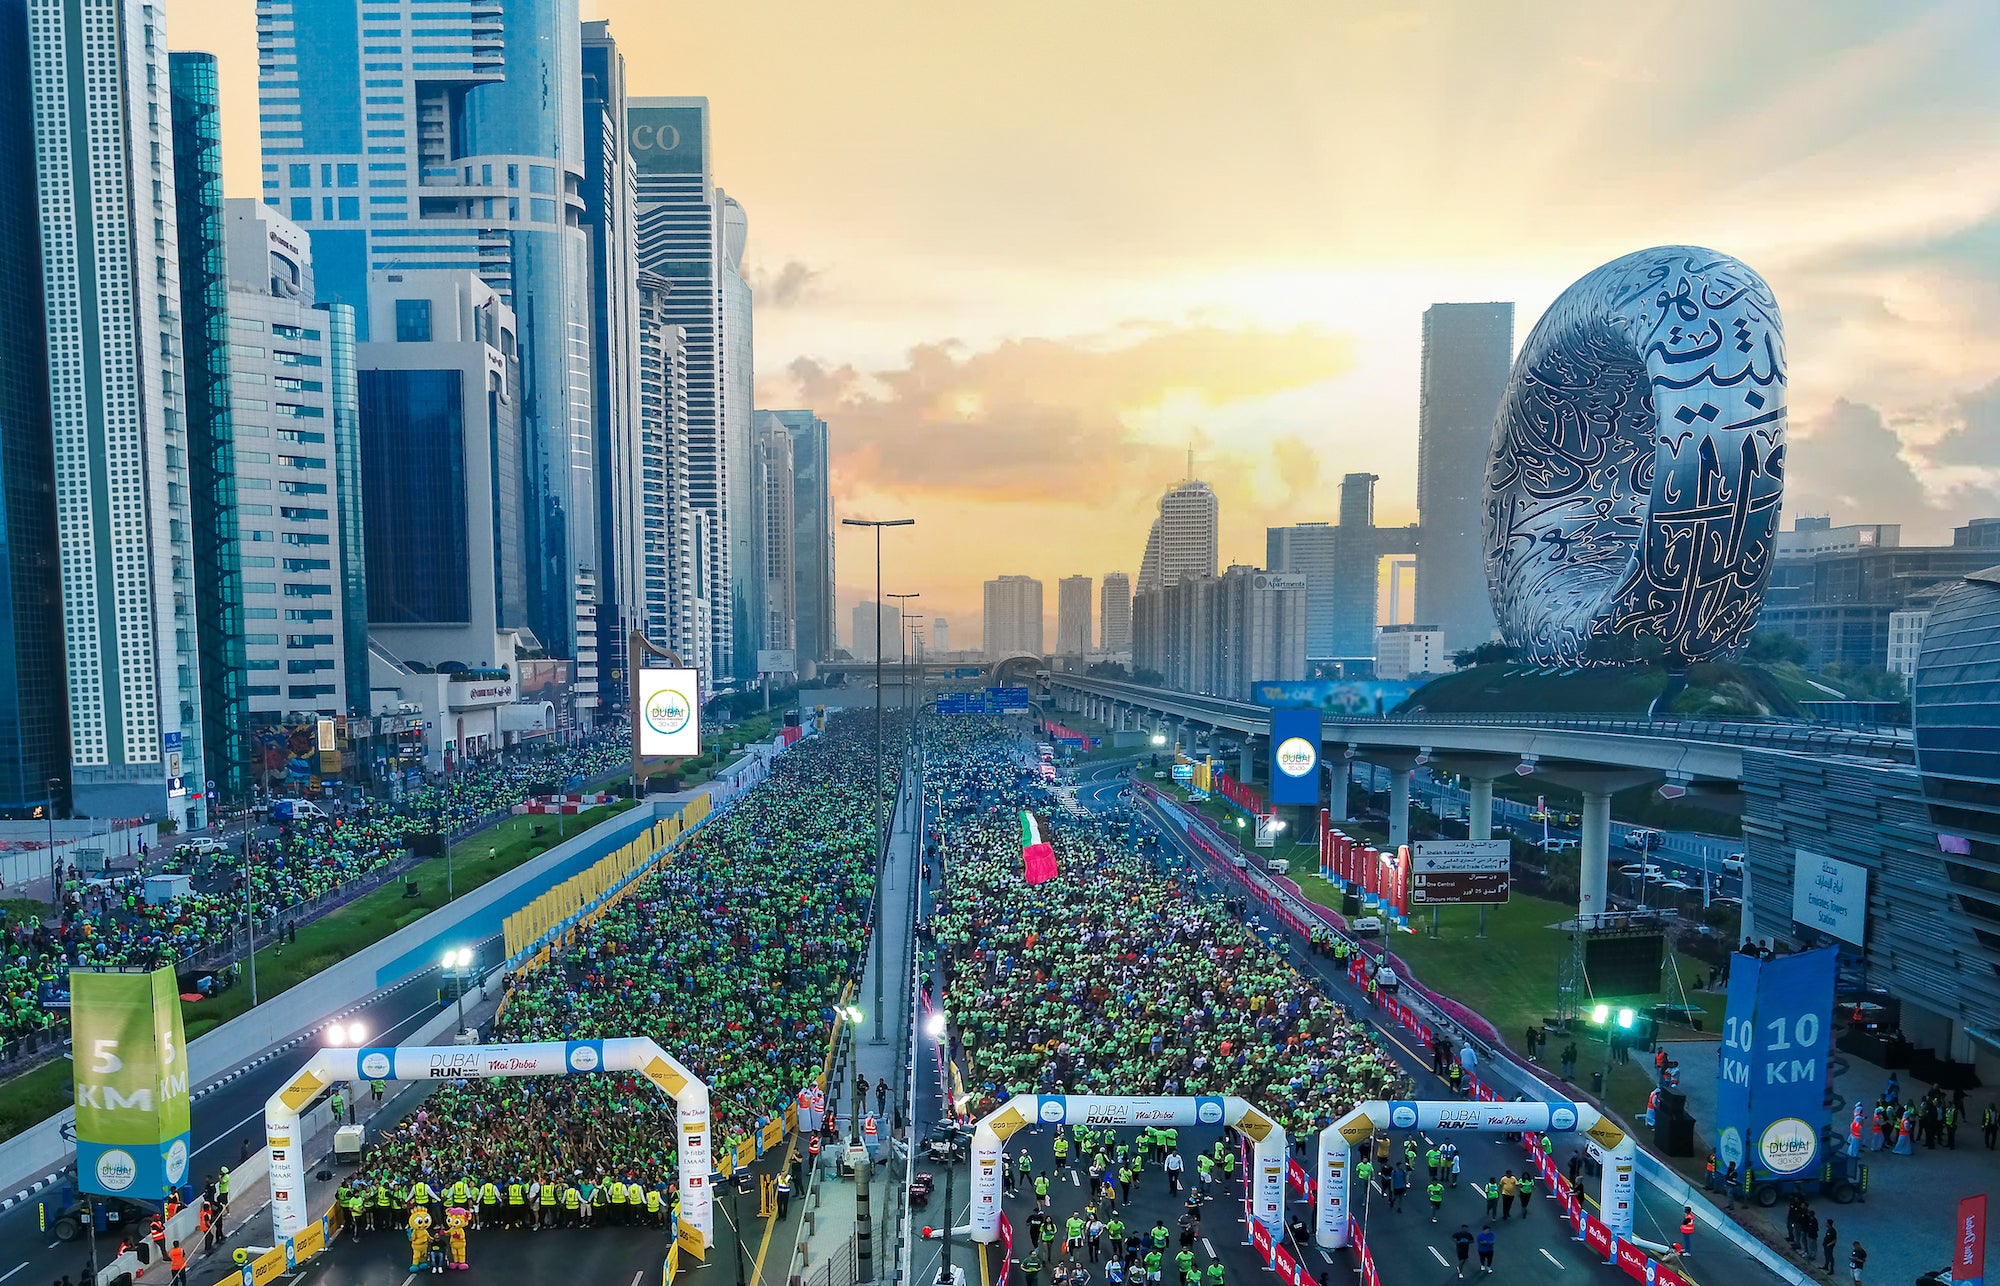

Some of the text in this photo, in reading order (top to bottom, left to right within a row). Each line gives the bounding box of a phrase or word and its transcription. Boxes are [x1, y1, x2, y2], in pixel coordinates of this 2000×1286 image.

[652, 708, 684, 718] DUBAI
[1282, 754, 1310, 762] DUBAI
[1808, 893, 1848, 916] Emirates Towers
[1818, 910, 1836, 926] Station
[1726, 1016, 1753, 1053] 10
[1767, 1013, 1820, 1051] 10
[163, 1031, 176, 1065] 5
[92, 1039, 122, 1074] 5
[430, 1053, 480, 1068] DUBAI
[488, 1058, 538, 1071] Mai Dubai
[1766, 1058, 1816, 1085] KM
[430, 1068, 462, 1078] RUN
[1722, 1057, 1750, 1088] KM
[160, 1071, 186, 1103] KM
[78, 1083, 154, 1112] KM
[1088, 1104, 1129, 1116] DUBAI
[1152, 1110, 1175, 1120] Dubai
[1440, 1109, 1480, 1121] DUBAI
[1086, 1116, 1114, 1124] RUN
[1437, 1121, 1466, 1129] RUN
[1505, 1115, 1528, 1125] Dubai
[1770, 1140, 1809, 1154] DUBAI
[102, 1166, 132, 1176] DUBAI
